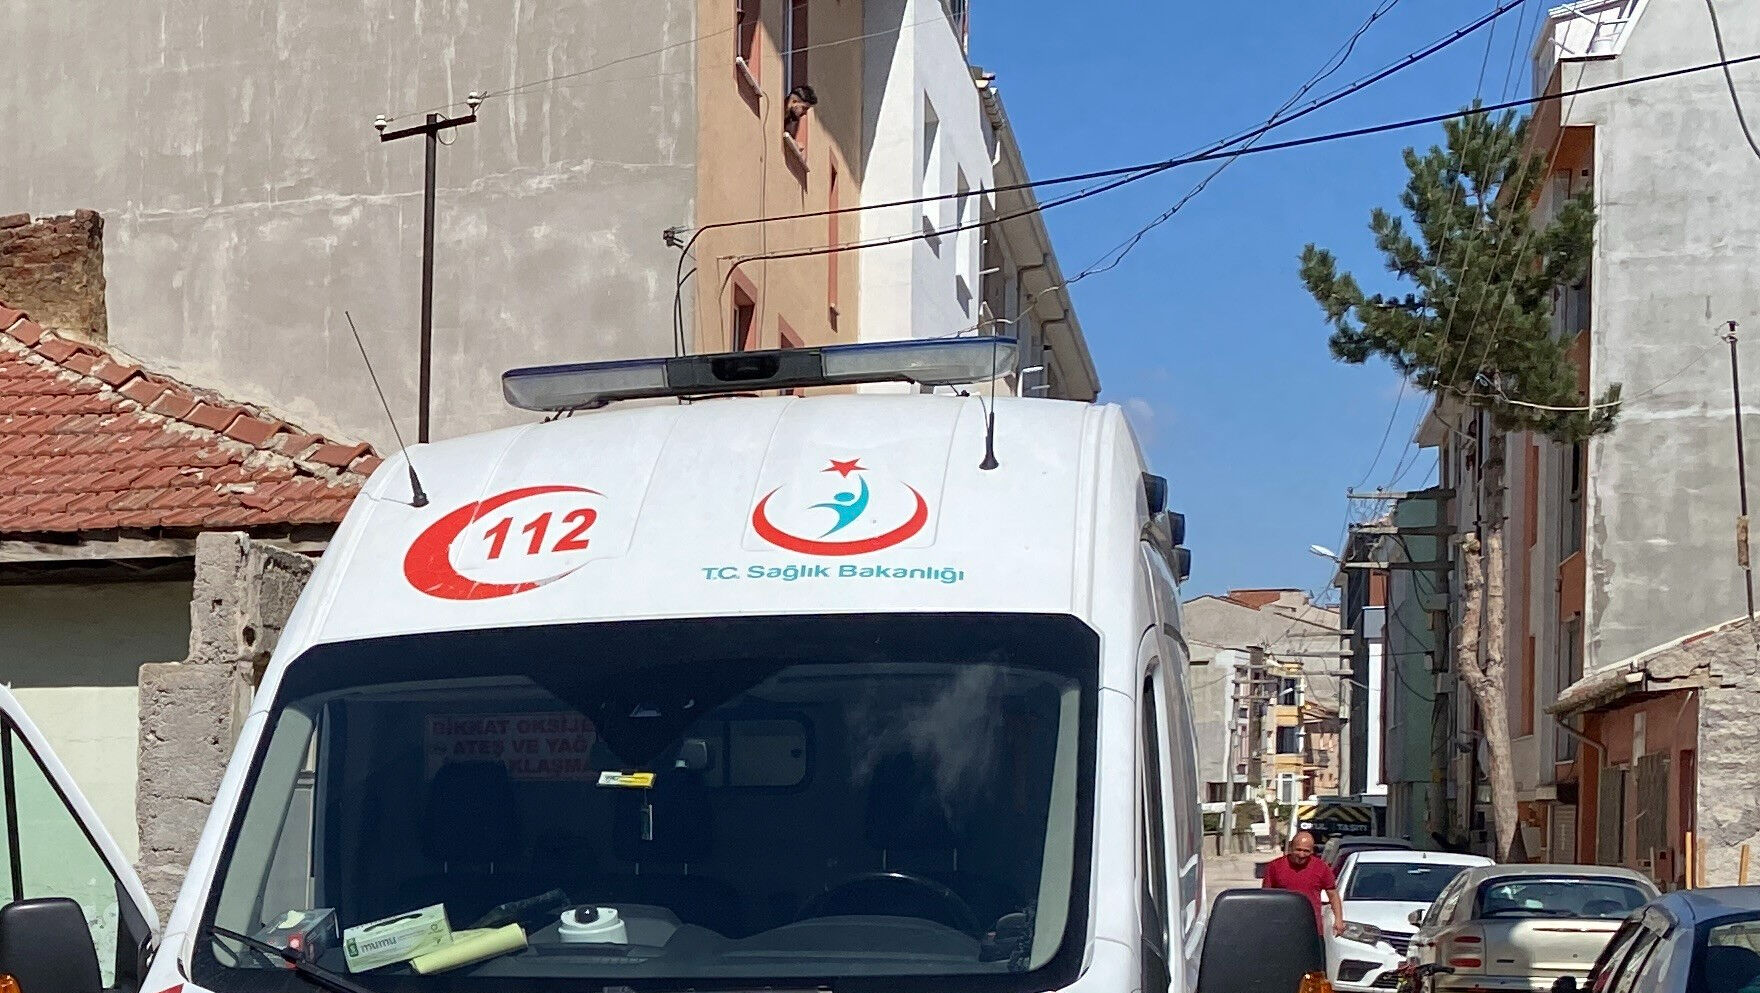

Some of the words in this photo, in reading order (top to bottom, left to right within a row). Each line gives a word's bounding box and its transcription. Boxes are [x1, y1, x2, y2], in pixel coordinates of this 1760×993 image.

[482, 508, 598, 560] 112
[747, 565, 831, 582] Sağlık
[839, 564, 966, 584] Bakanlığı
